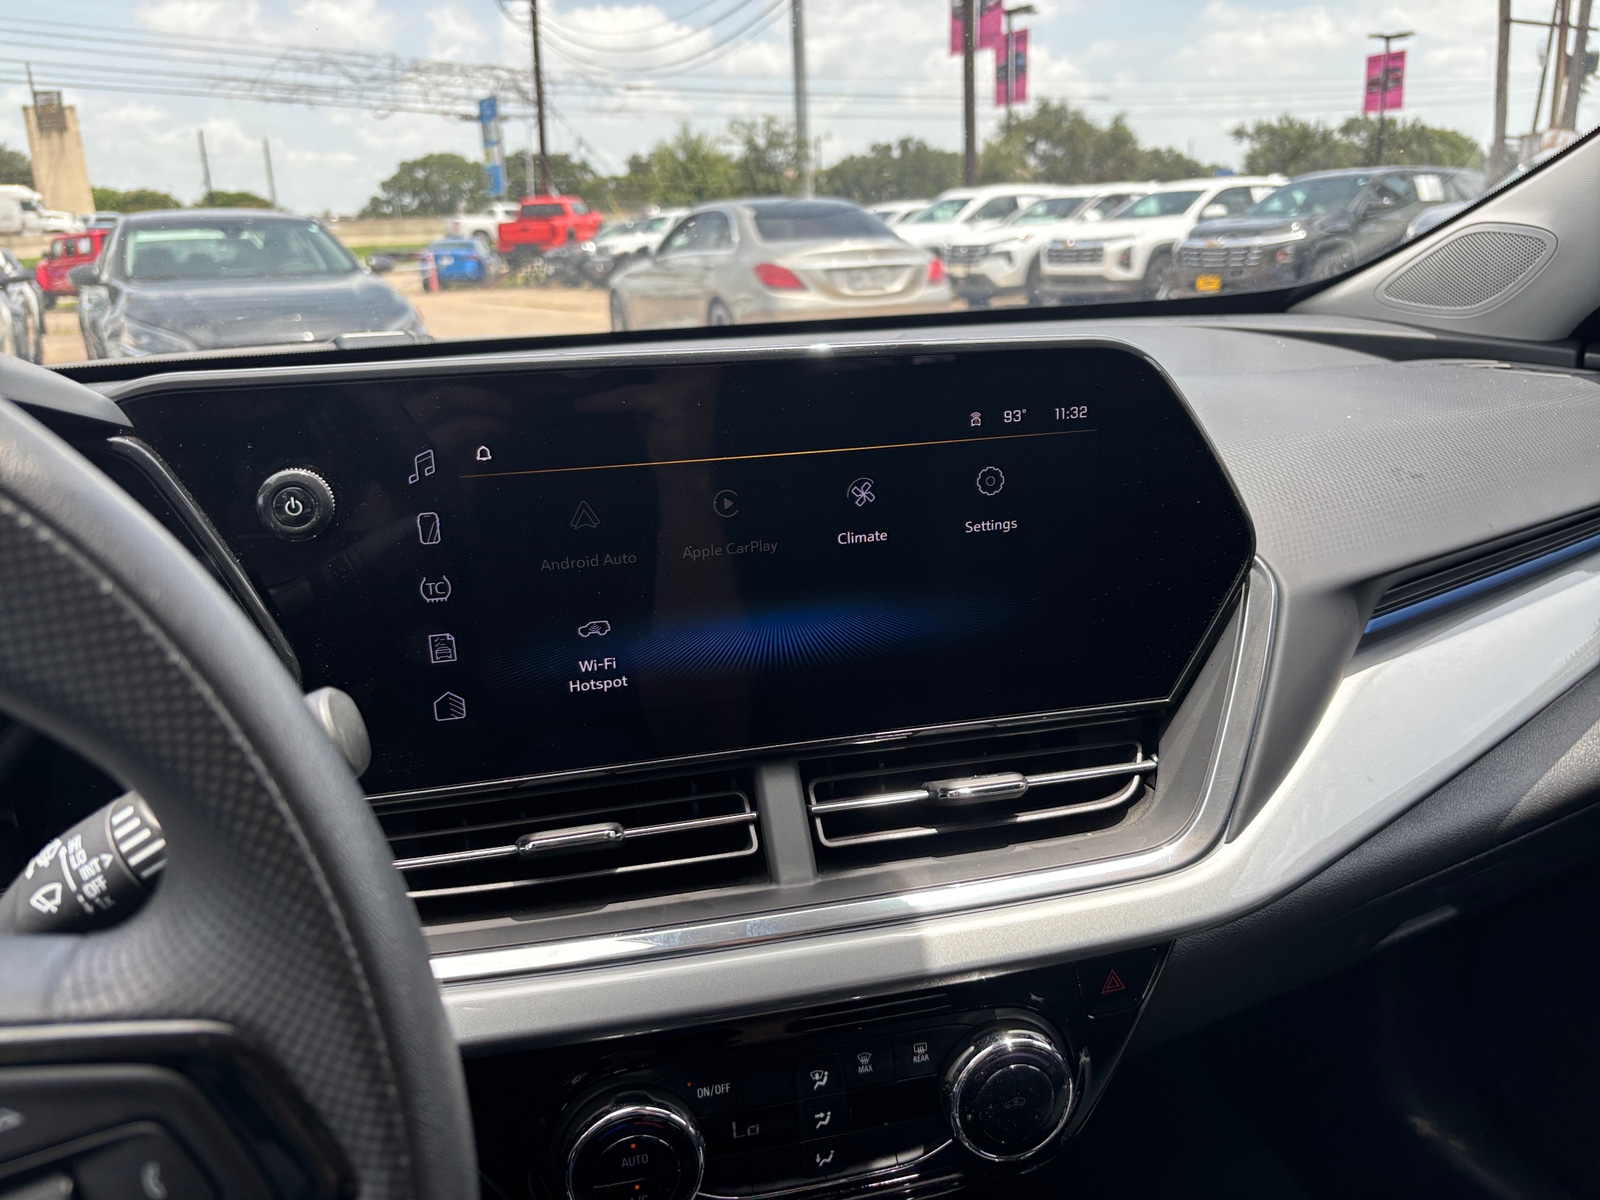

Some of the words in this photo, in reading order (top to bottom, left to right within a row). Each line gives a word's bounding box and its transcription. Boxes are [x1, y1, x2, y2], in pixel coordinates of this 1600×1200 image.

[1003, 408, 1027, 423] 93°
[1055, 406, 1088, 420] 11:32
[965, 518, 1018, 533] Settings
[837, 530, 888, 545] Climate
[683, 544, 723, 561] Apple
[726, 540, 778, 556] CarPlay
[540, 556, 600, 571] Android
[603, 553, 637, 566] Auto
[425, 582, 446, 595] TC
[578, 657, 617, 672] Wi-Fi
[569, 675, 628, 692] Hotspot
[79, 856, 102, 881] INT
[82, 874, 108, 899] OFF
[912, 1053, 930, 1063] REAR
[858, 1064, 873, 1074] MAX
[697, 1083, 731, 1098] ON/OFF
[621, 1153, 649, 1168] AUTO
